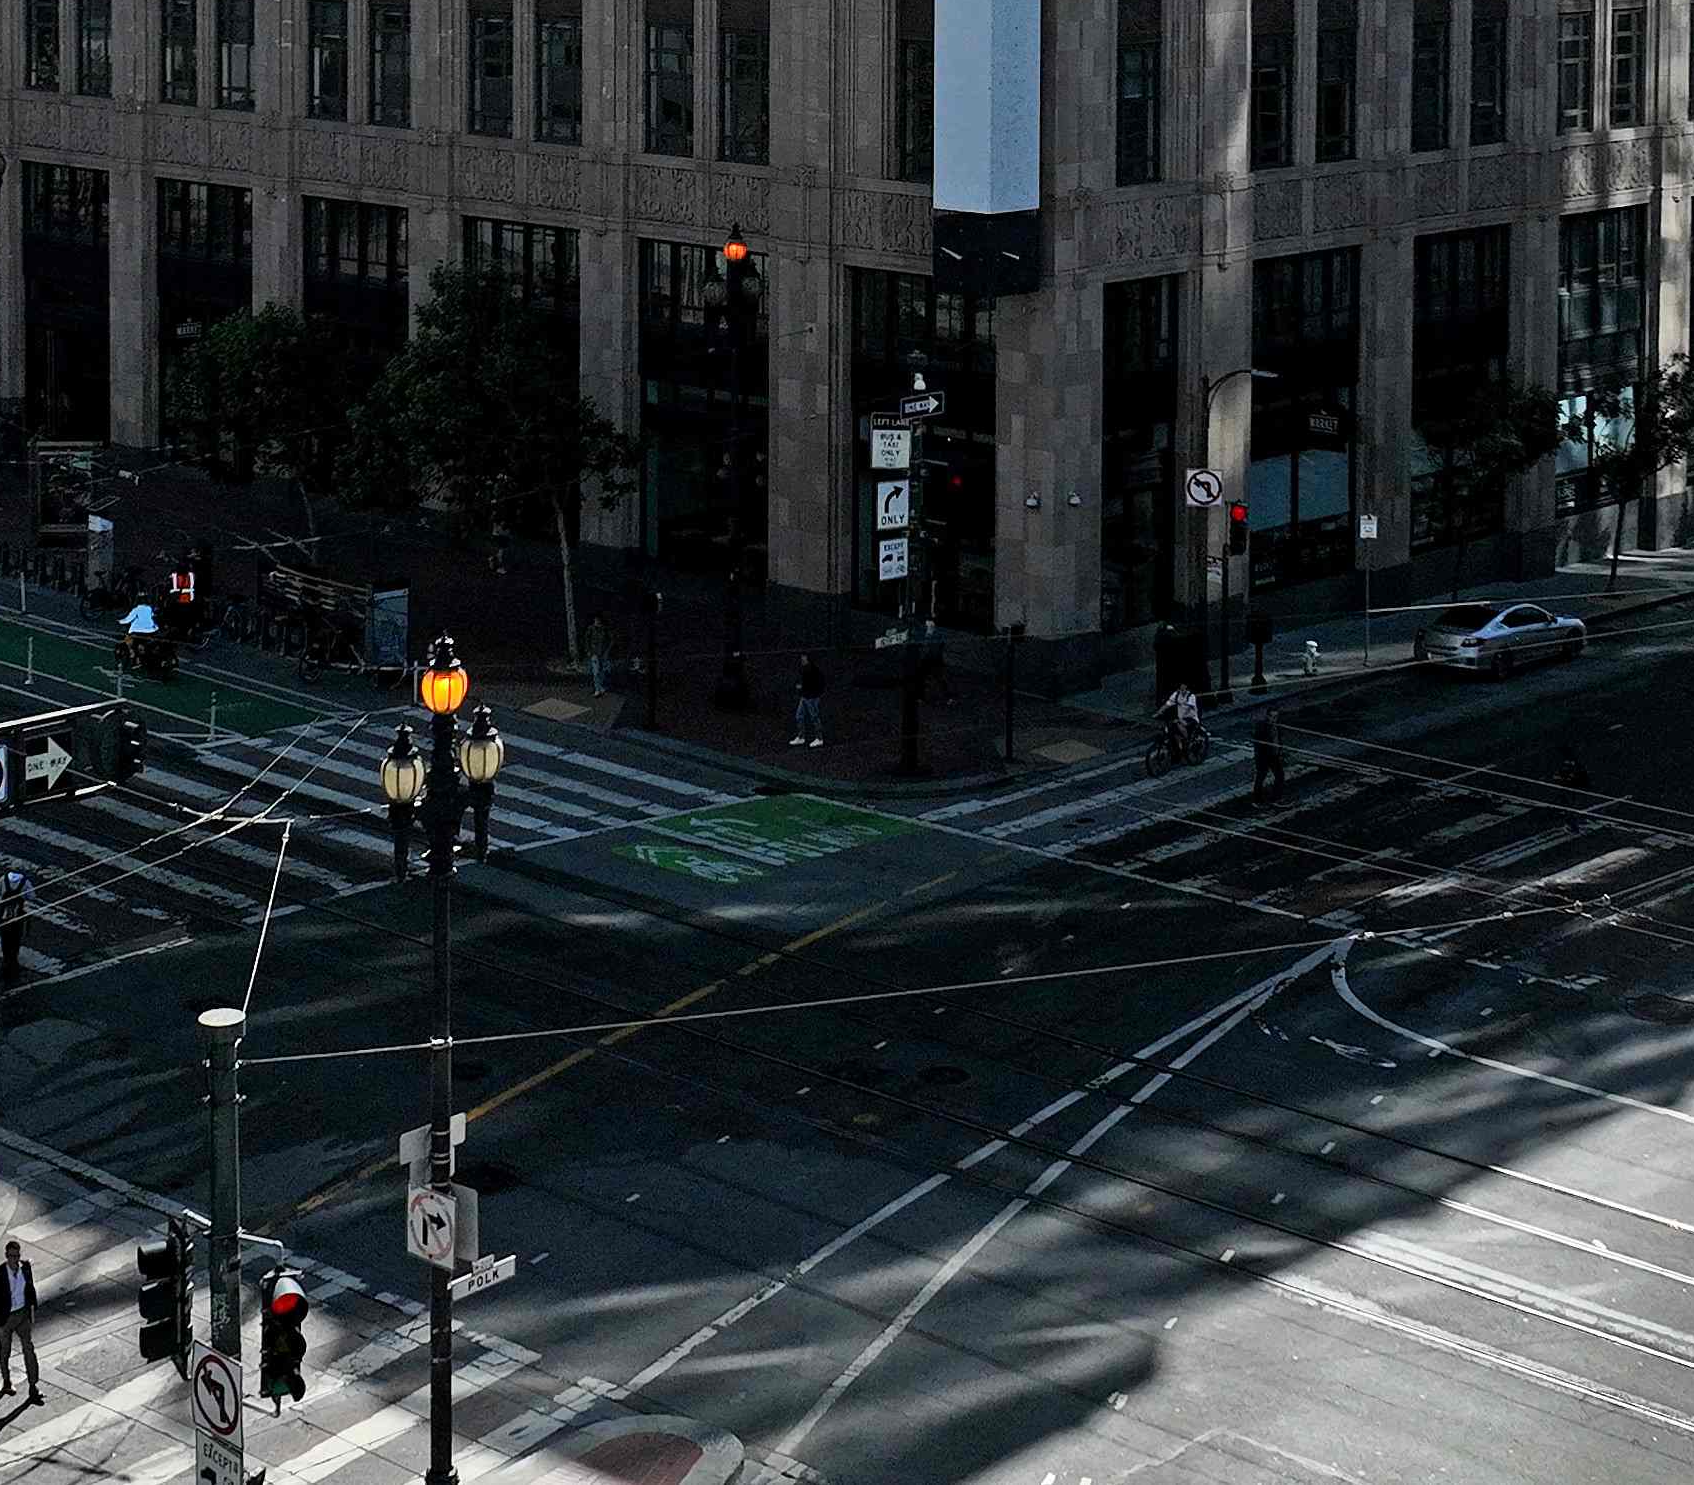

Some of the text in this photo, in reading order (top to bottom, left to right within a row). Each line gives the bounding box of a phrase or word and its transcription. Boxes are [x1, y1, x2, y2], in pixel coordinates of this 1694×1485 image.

[881, 515, 905, 525] ONLY
[27, 754, 68, 773] ONE WAY
[467, 1269, 500, 1292] POLK
